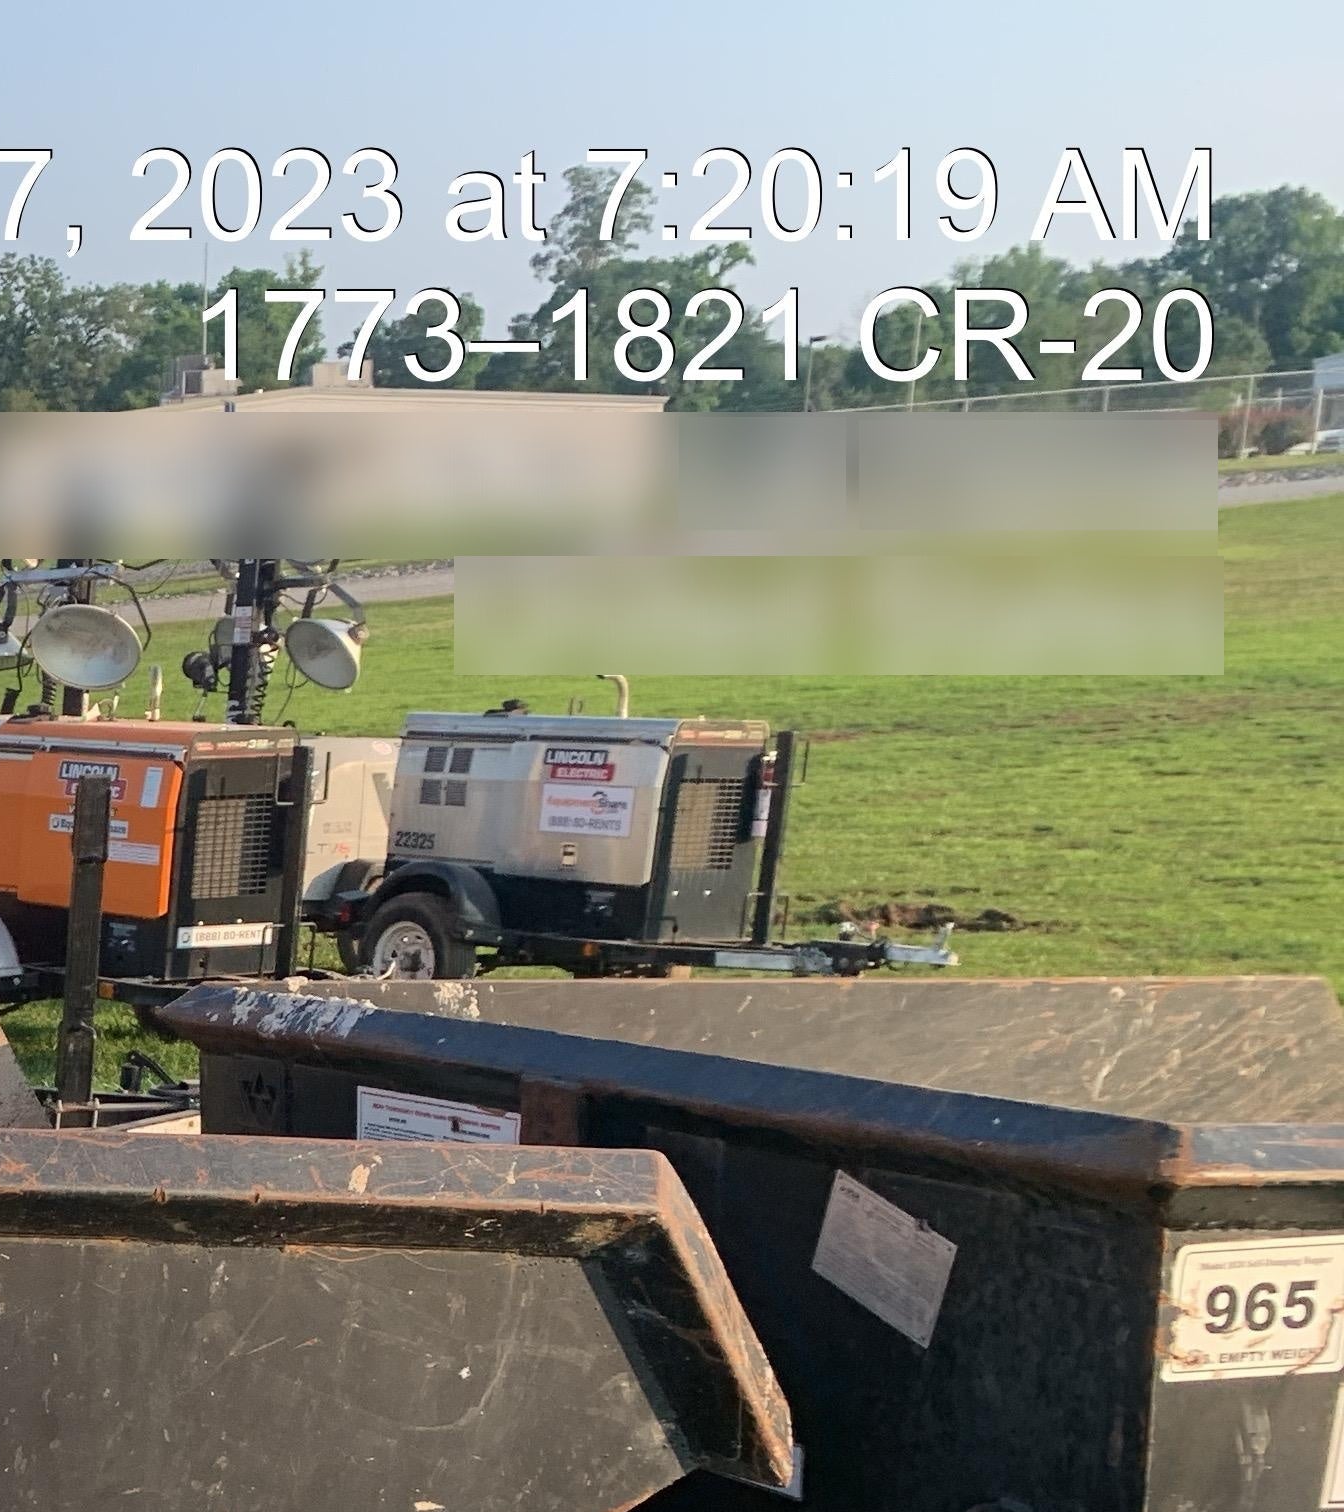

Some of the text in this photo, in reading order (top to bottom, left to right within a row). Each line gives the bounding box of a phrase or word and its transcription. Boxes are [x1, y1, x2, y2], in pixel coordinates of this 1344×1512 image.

[545, 750, 606, 766] LINCOLN
[61, 763, 118, 781] LINCOLN
[555, 767, 609, 780] ELECTRIC
[394, 831, 436, 850] 22325
[1205, 1280, 1320, 1334] 965
[1219, 1350, 1266, 1364] EMPTY
